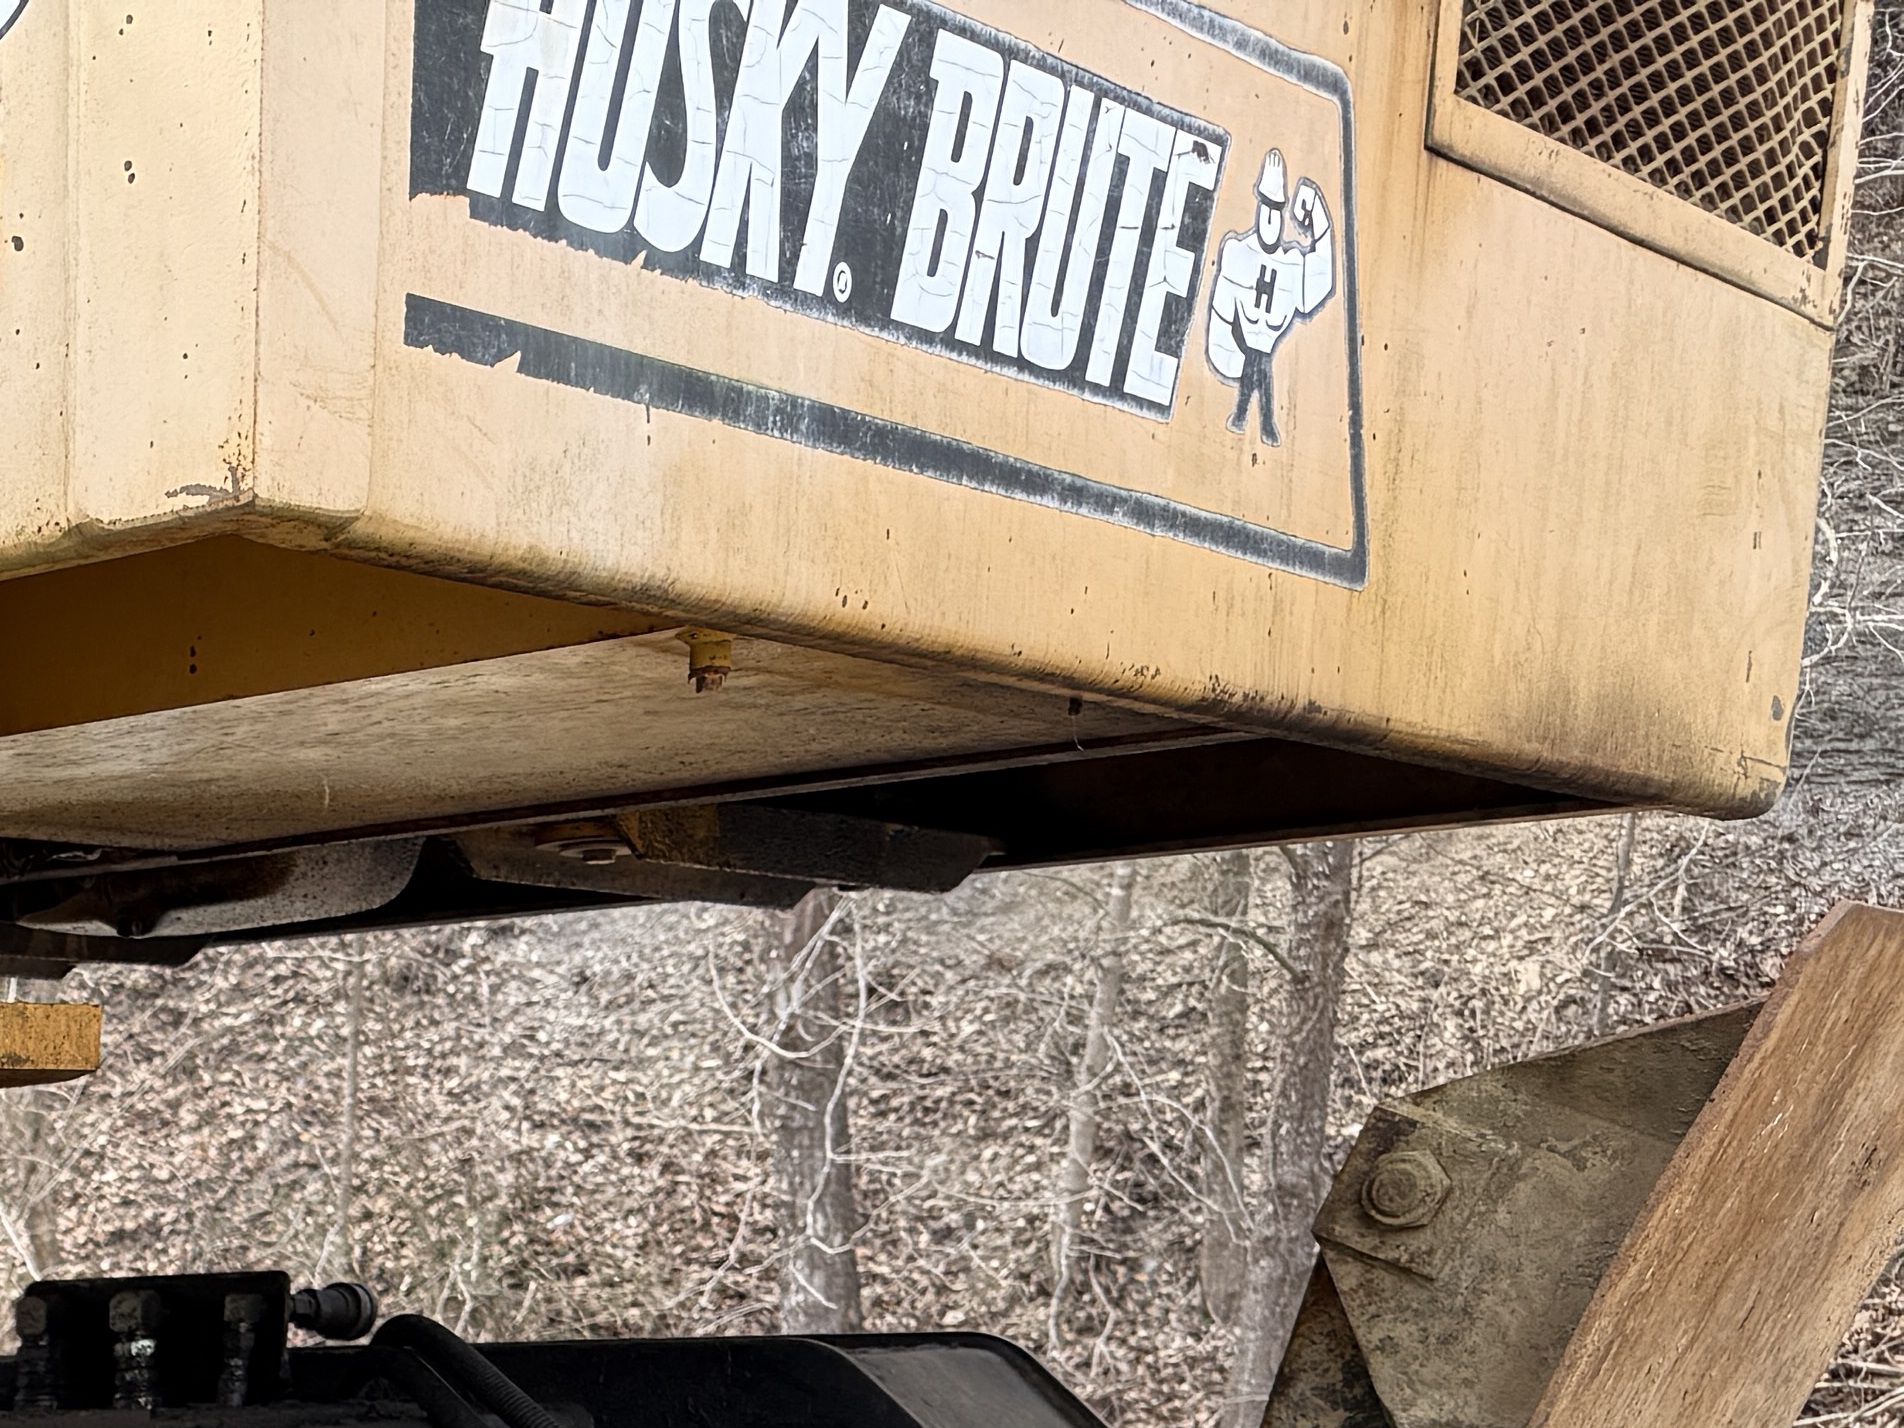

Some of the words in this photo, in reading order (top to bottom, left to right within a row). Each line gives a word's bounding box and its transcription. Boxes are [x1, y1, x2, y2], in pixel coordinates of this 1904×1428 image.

[465, 0, 912, 298] HUSKY
[890, 28, 1224, 407] BRUTE
[1254, 263, 1277, 314] H
